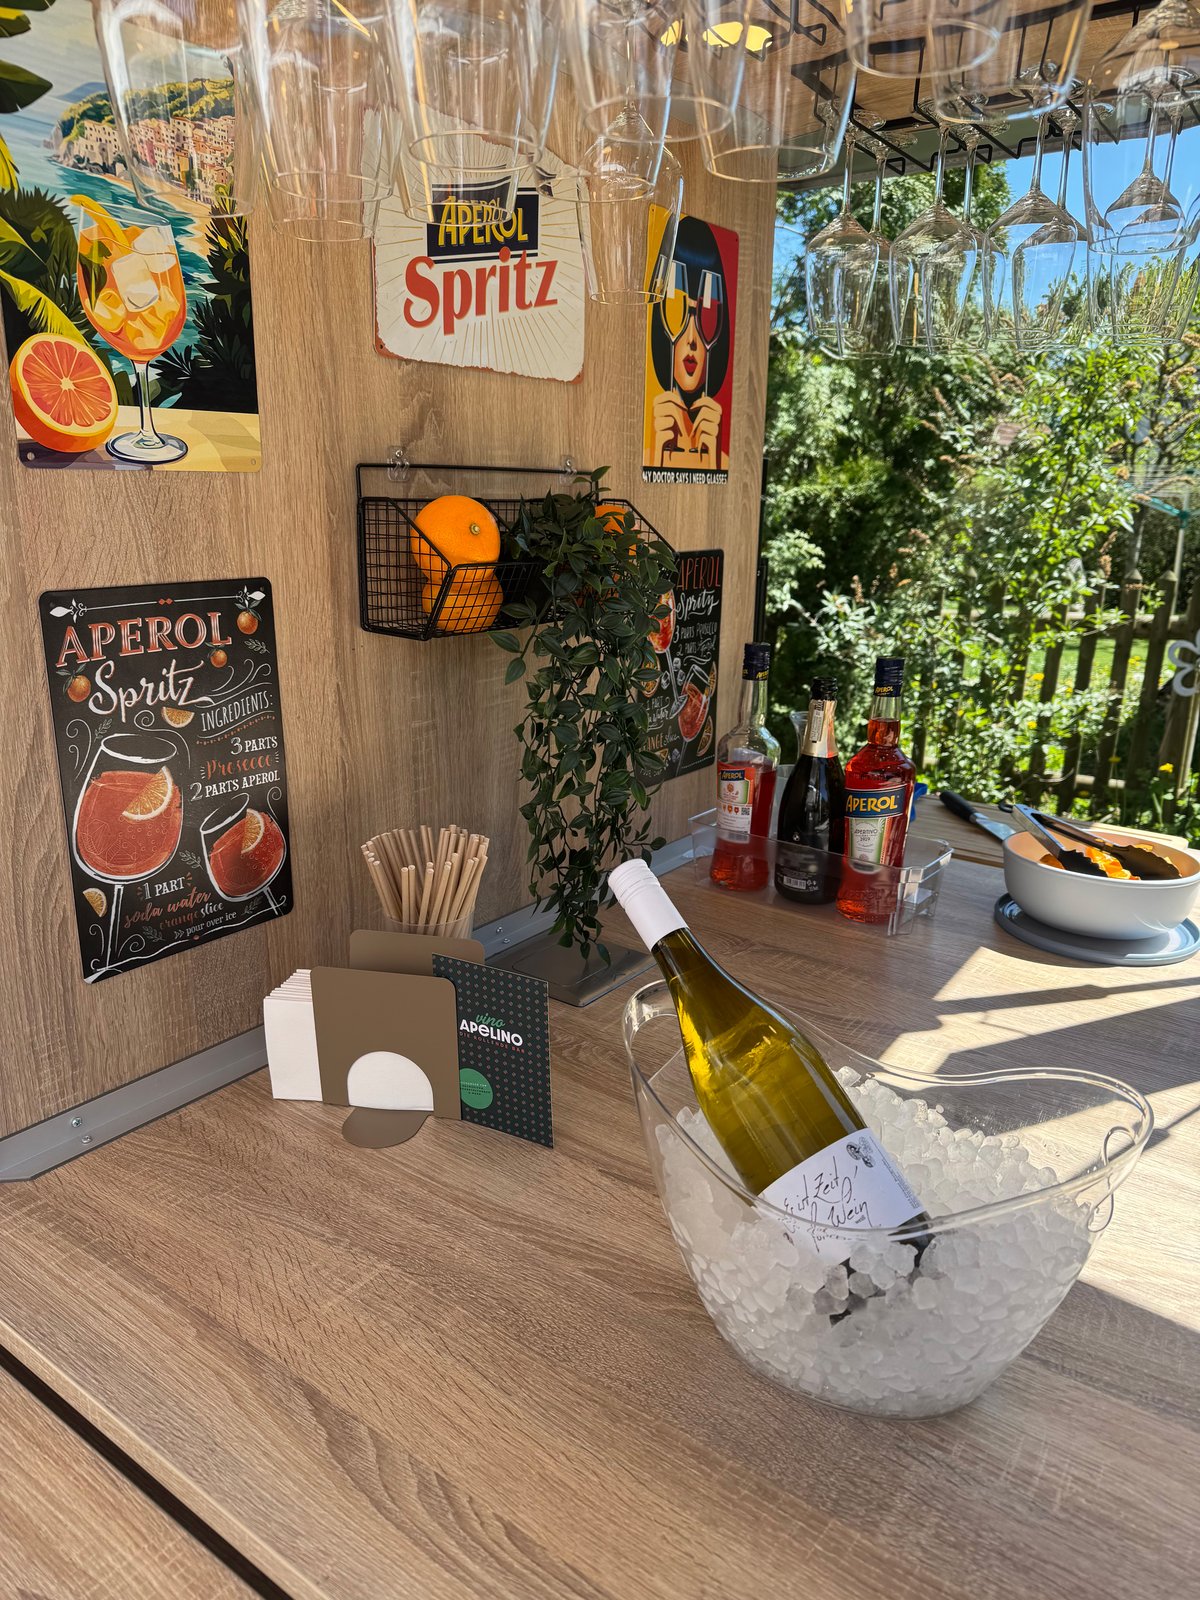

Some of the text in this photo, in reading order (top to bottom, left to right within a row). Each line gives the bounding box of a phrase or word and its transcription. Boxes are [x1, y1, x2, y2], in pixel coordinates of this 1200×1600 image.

[438, 196, 529, 248] APEROL
[403, 246, 559, 337] Spritz
[642, 471, 652, 483] MY
[653, 471, 675, 484] DOCTOR
[676, 472, 689, 484] SAYS
[693, 472, 706, 485] NEED
[706, 473, 728, 485] GLASSES
[677, 556, 721, 591] APEROL
[676, 589, 720, 621] Spritz
[55, 611, 233, 668] APEROL
[673, 625, 680, 643] 3
[680, 626, 695, 639] PARTS
[676, 644, 684, 656] 2
[88, 658, 216, 724] Spritz
[201, 690, 274, 732] INGREDIENTS:
[230, 736, 278, 755] 3 PARTS
[207, 754, 271, 780] Prosecco
[190, 770, 281, 801] 2 PARTS APEROL
[846, 794, 898, 812] APEROL
[143, 876, 186, 900] 1 PART
[123, 886, 212, 929] soda water
[200, 901, 225, 918] slice
[185, 911, 237, 937] pour over ice
[475, 1012, 506, 1028] vino
